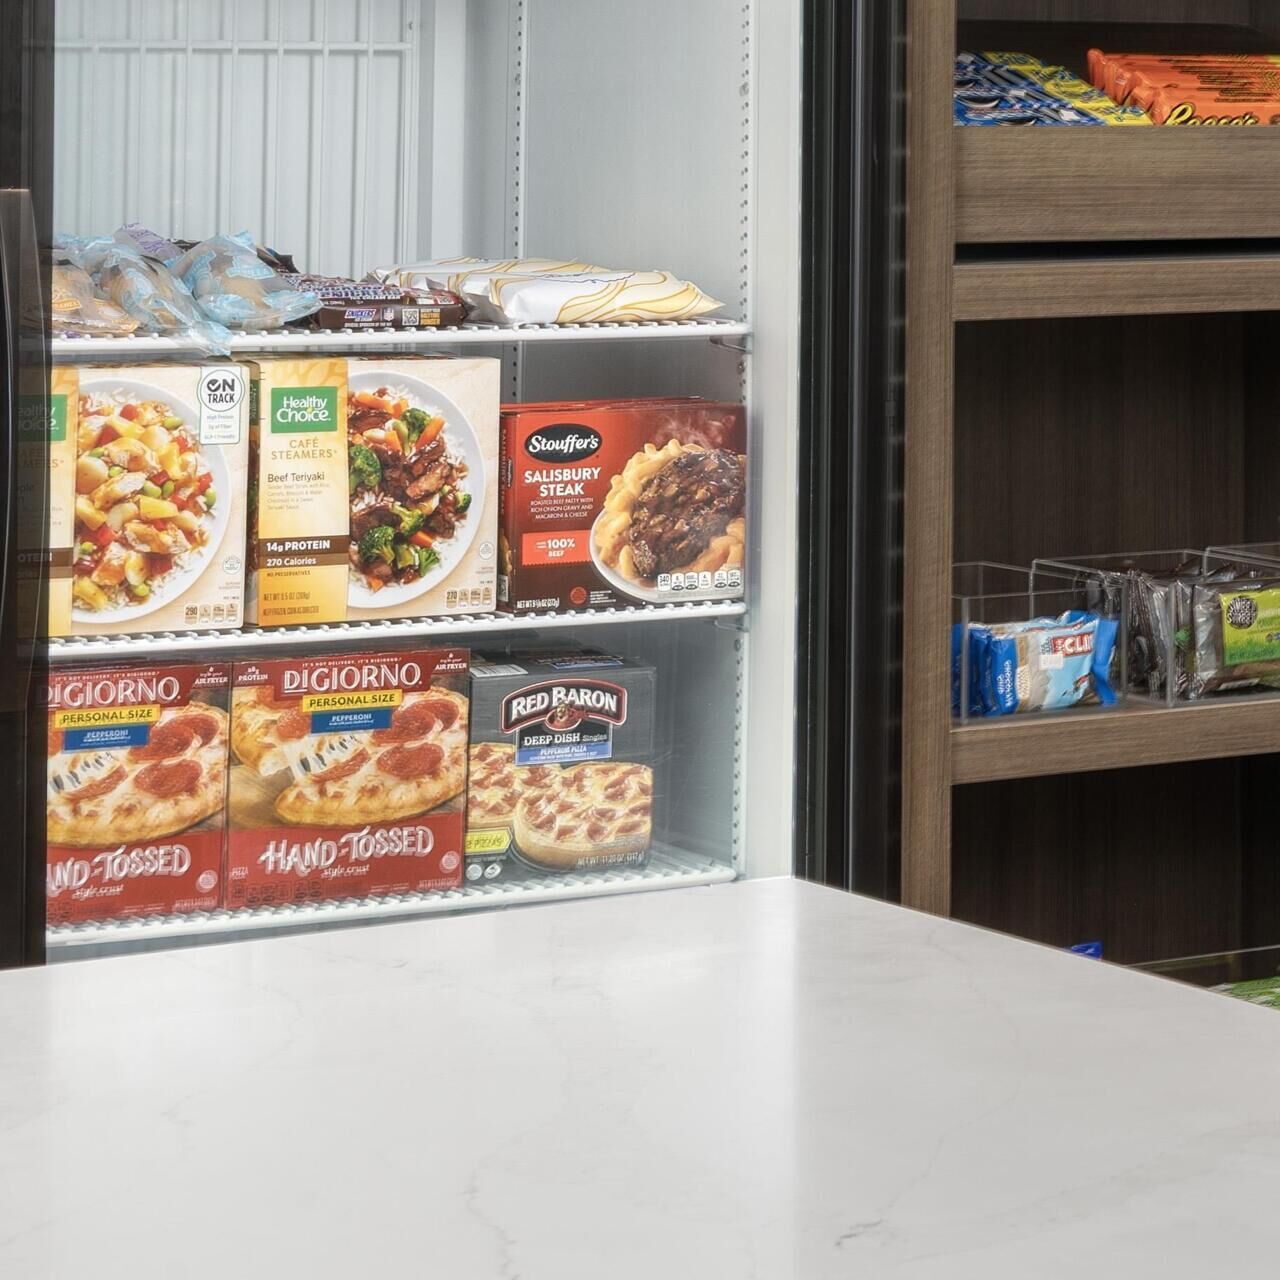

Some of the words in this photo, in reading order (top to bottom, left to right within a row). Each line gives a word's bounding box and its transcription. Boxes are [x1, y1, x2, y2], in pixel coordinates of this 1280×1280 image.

[207, 393, 235, 404] TRACK
[282, 395, 328, 411] Healthy
[276, 407, 330, 424] Choice
[289, 437, 319, 449] CAFÉ
[528, 433, 599, 455] Stouffer's
[271, 449, 334, 460] STEAMERS
[267, 473, 289, 483] Beef
[290, 472, 325, 482] Teriyaki
[524, 467, 601, 484] SALISBURY
[540, 483, 585, 497] STEAK
[266, 542, 283, 552] 14g
[284, 540, 331, 551] PROTEIN
[547, 538, 576, 549] 100%
[266, 558, 282, 567] 270
[284, 557, 317, 566] Calories
[238, 673, 268, 682] PROTEIN
[310, 696, 369, 708] PERSONAL
[371, 693, 396, 704] SIZE
[511, 694, 550, 721] RED
[552, 686, 618, 713] BARON
[62, 712, 125, 724] PERSONAL
[127, 709, 153, 720] SIZE
[331, 713, 372, 722] PEPPERONI
[86, 730, 129, 738] PEPPERONI
[524, 735, 553, 746] DEEP
[554, 732, 580, 744] DISH
